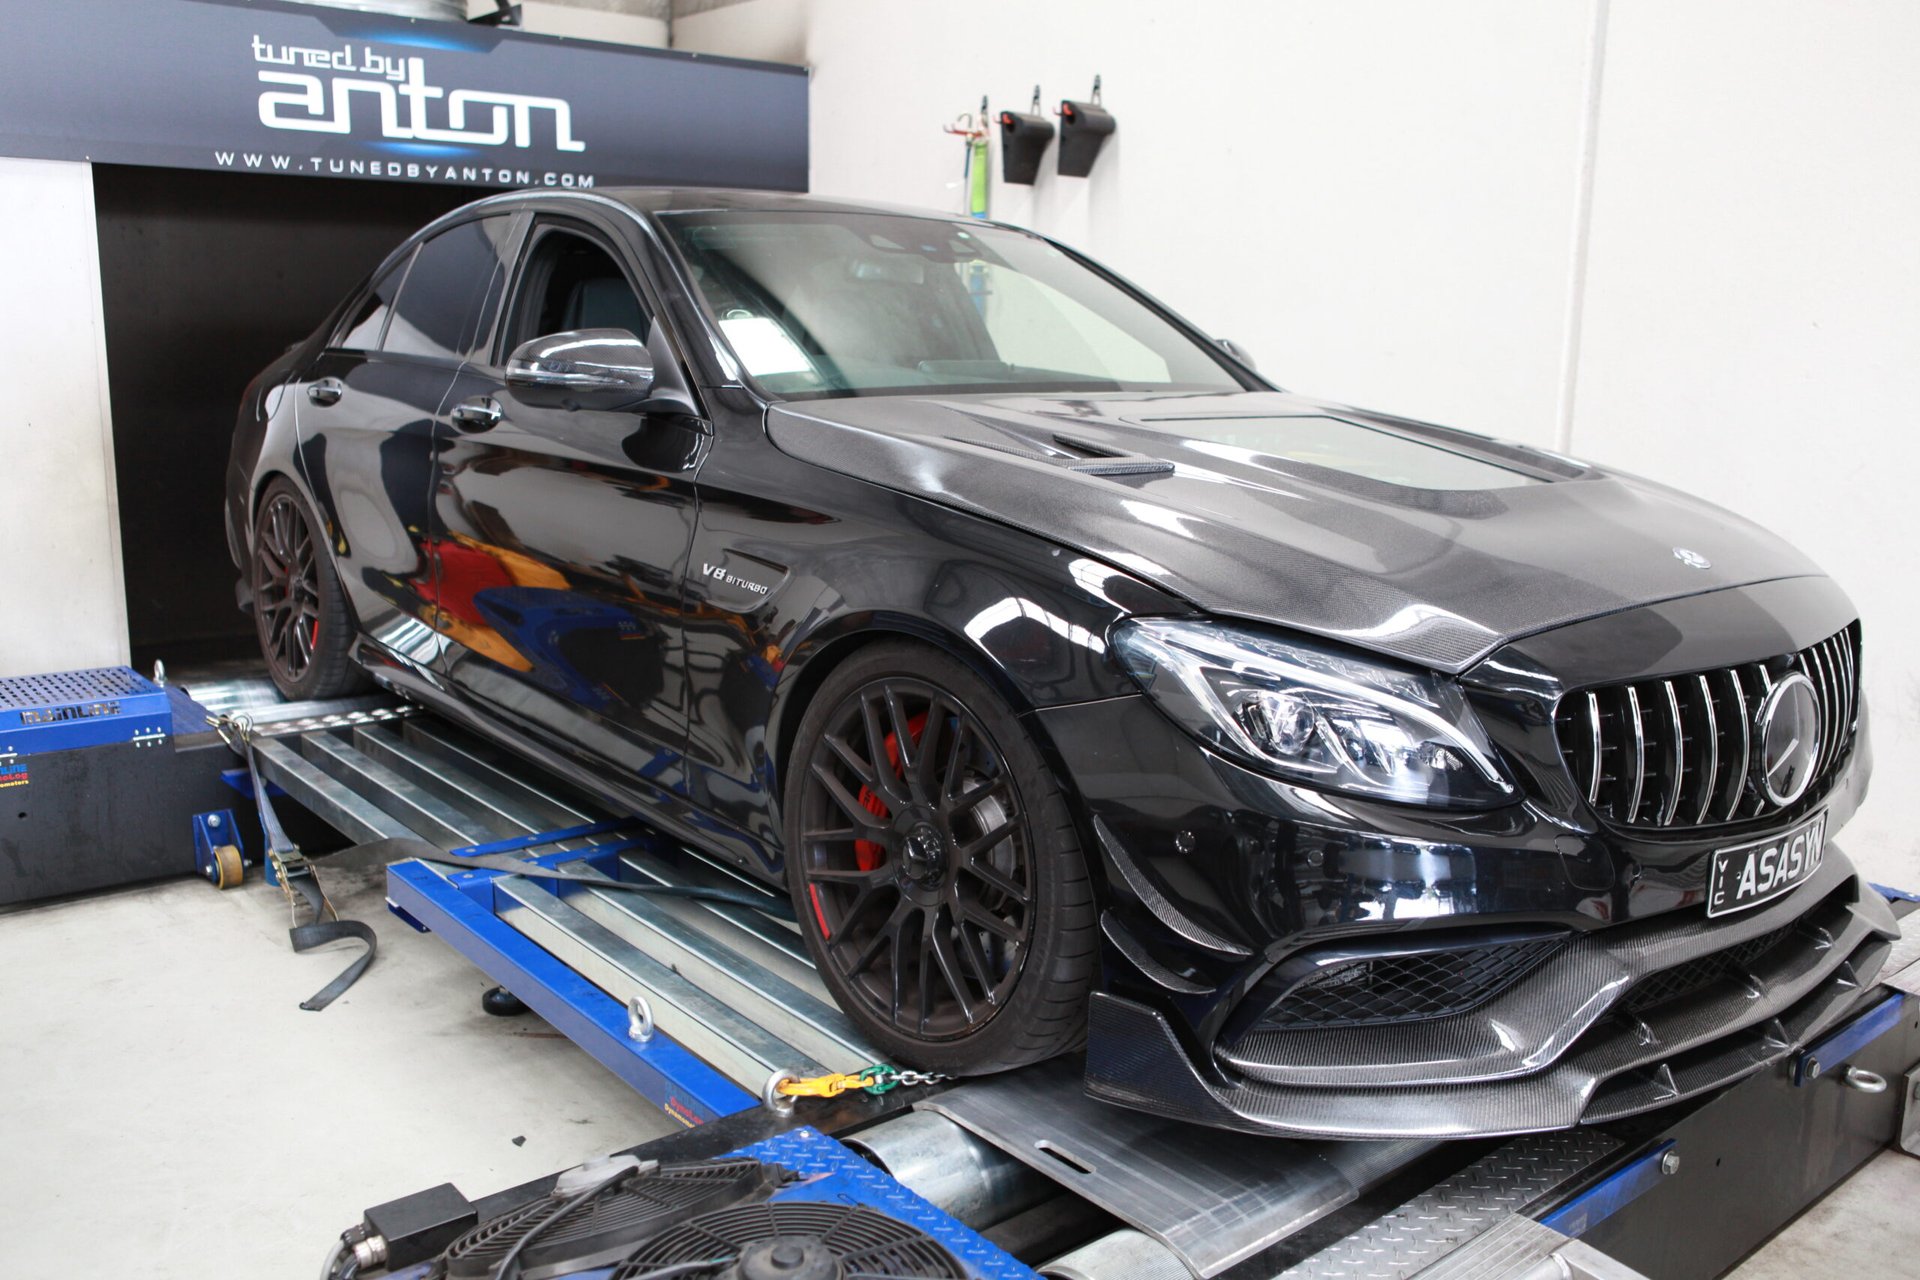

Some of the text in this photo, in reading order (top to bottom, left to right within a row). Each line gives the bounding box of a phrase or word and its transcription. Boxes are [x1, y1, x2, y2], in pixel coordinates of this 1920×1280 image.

[251, 34, 406, 82] tuned by
[258, 57, 586, 152] anton
[215, 151, 595, 189] WWW.TUNEDBYANTON.COM
[703, 563, 769, 595] V8 BITURBO
[1735, 819, 1825, 900] ASASYN
